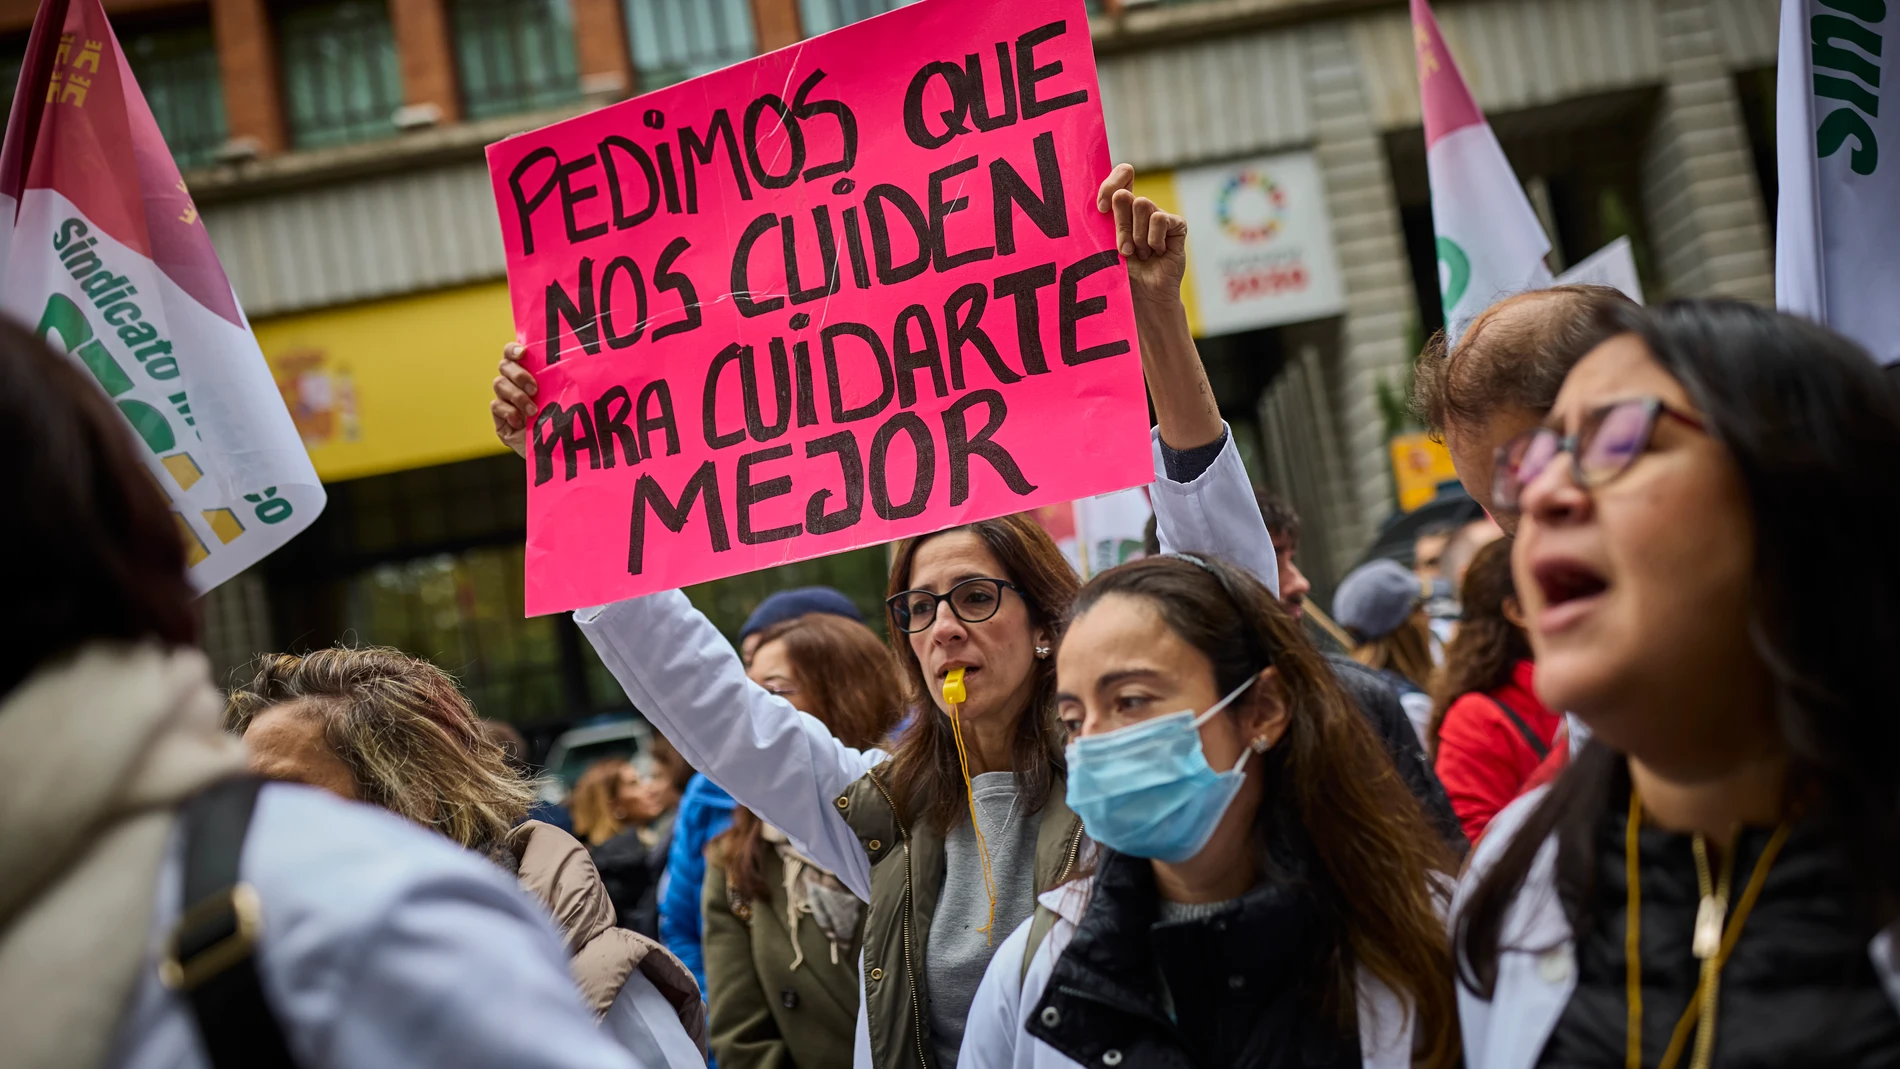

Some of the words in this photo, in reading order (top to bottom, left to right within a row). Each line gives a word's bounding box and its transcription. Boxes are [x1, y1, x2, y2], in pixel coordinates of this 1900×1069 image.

[903, 20, 1089, 150] QUE
[53, 217, 181, 381] Sindicato
[545, 236, 702, 365] NOS
[532, 378, 681, 487] PARA
[627, 388, 1039, 576] MEJOR
